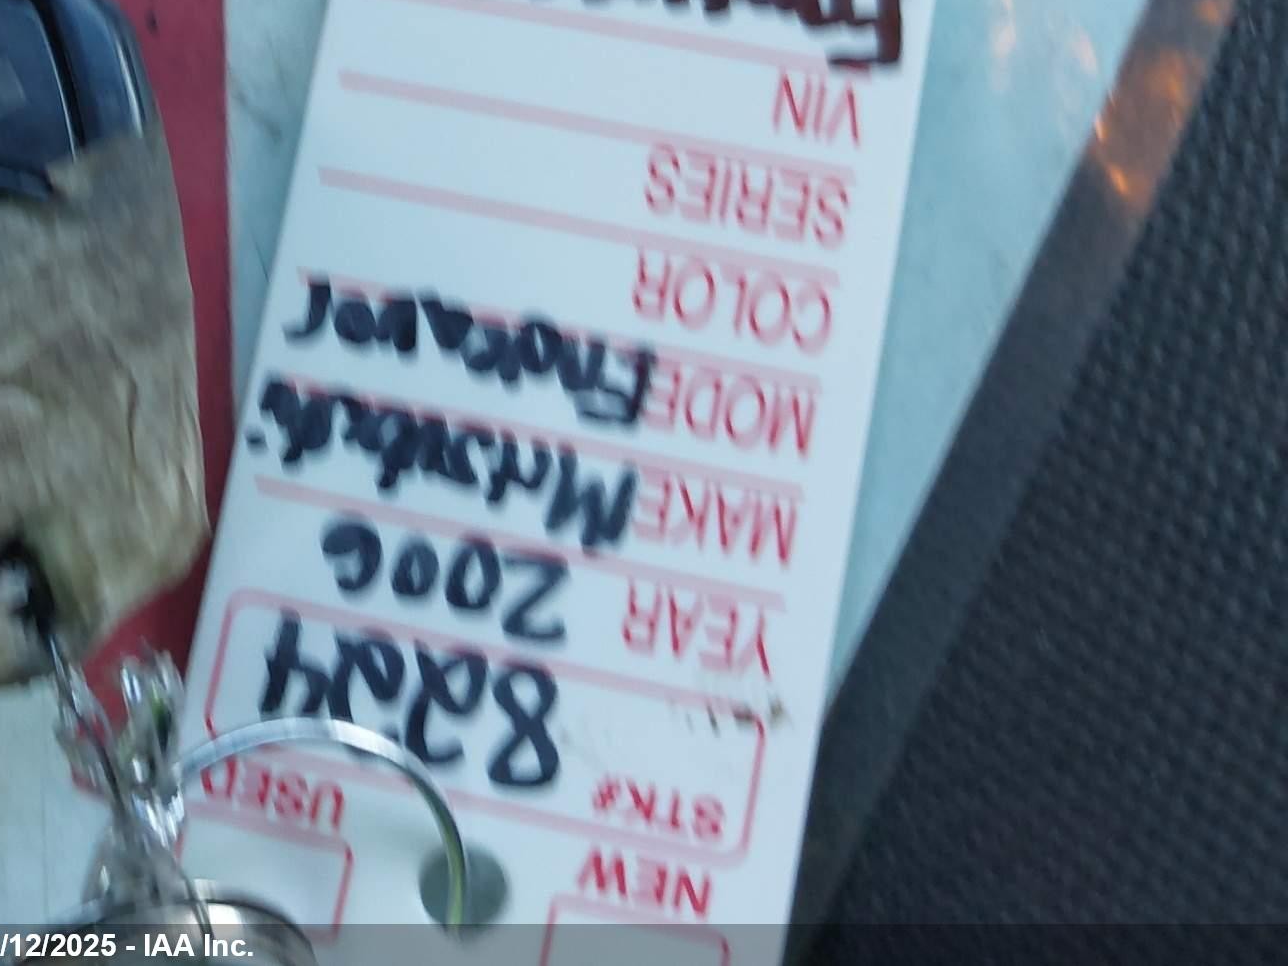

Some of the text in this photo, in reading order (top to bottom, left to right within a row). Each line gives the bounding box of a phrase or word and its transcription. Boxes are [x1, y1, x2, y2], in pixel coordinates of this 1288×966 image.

[774, 74, 862, 146] VIN
[645, 146, 849, 247] SERIES
[633, 249, 832, 351] COLOR
[634, 464, 800, 566] MAKE
[320, 517, 569, 643] 2006
[622, 579, 773, 679] YEAR
[260, 610, 560, 790] 8224
[592, 772, 726, 839] STK#
[578, 846, 712, 918] NEW
